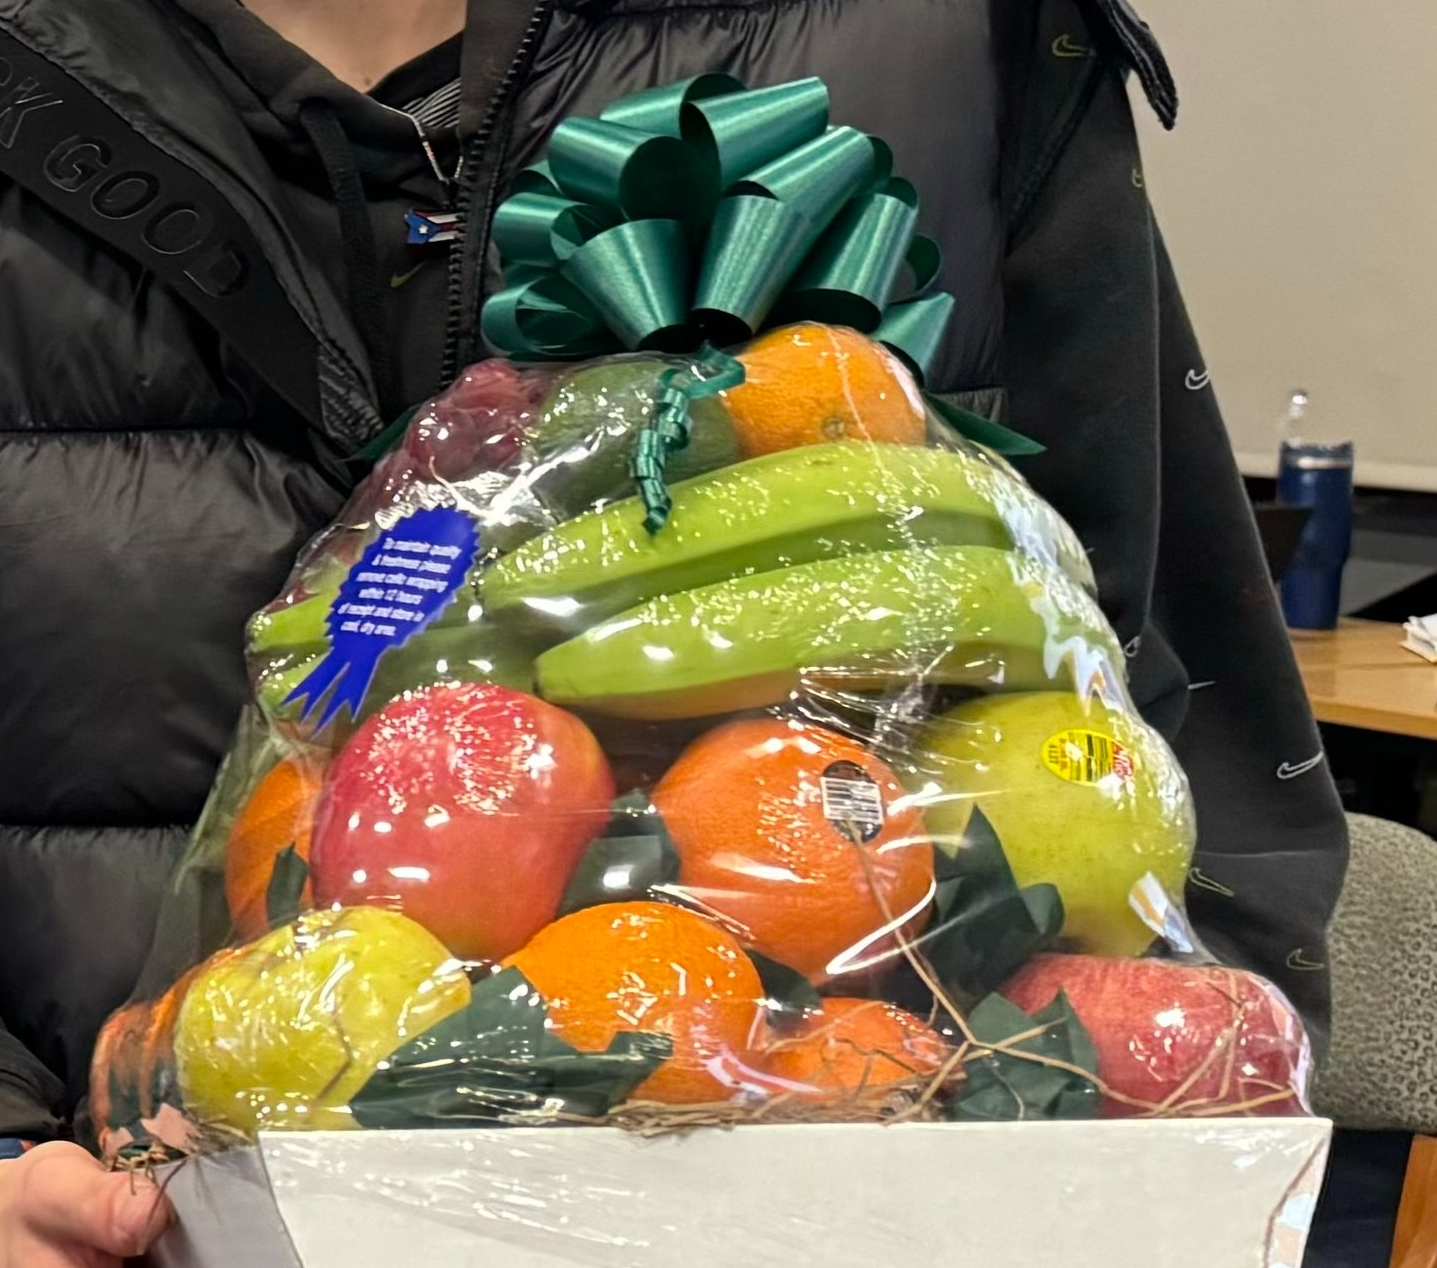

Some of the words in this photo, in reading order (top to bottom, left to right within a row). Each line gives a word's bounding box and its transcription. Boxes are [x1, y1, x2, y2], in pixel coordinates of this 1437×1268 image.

[41, 133, 251, 298] GOOD
[429, 544, 462, 560] quality
[406, 576, 449, 593] wrapping
[358, 587, 385, 600] within
[395, 589, 424, 605] hours
[372, 606, 394, 618] and
